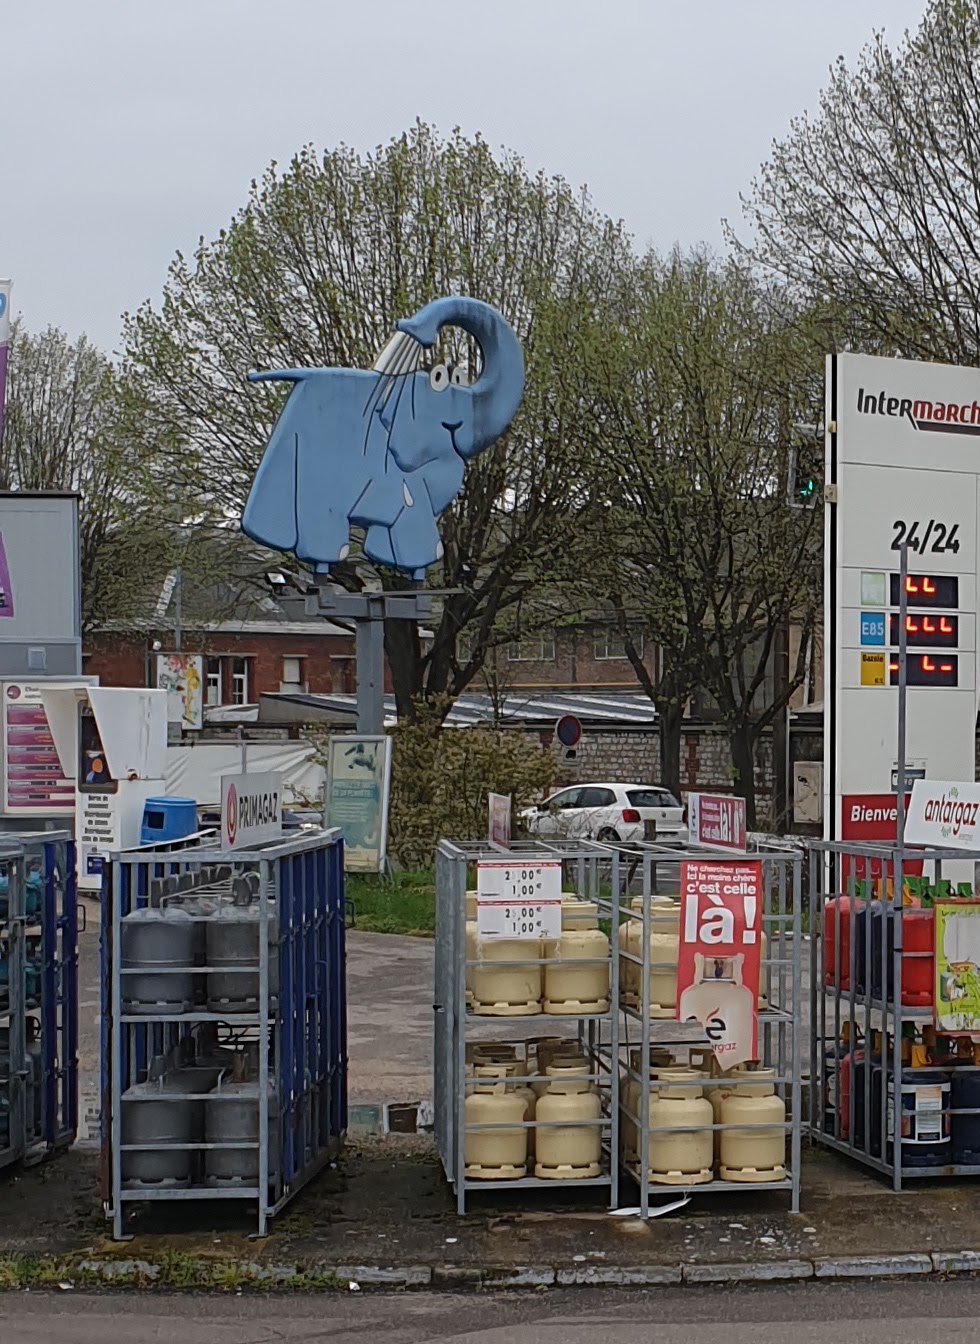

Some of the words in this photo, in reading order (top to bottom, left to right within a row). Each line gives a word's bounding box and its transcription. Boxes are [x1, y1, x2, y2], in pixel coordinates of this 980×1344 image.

[890, 519, 961, 555] 24/24
[862, 622, 884, 636] E85
[238, 792, 278, 830] PRIMAGAZ
[850, 805, 904, 822] Bienve
[924, 793, 980, 836] antargaz
[686, 881, 720, 894] c'est
[723, 882, 757, 895] celle
